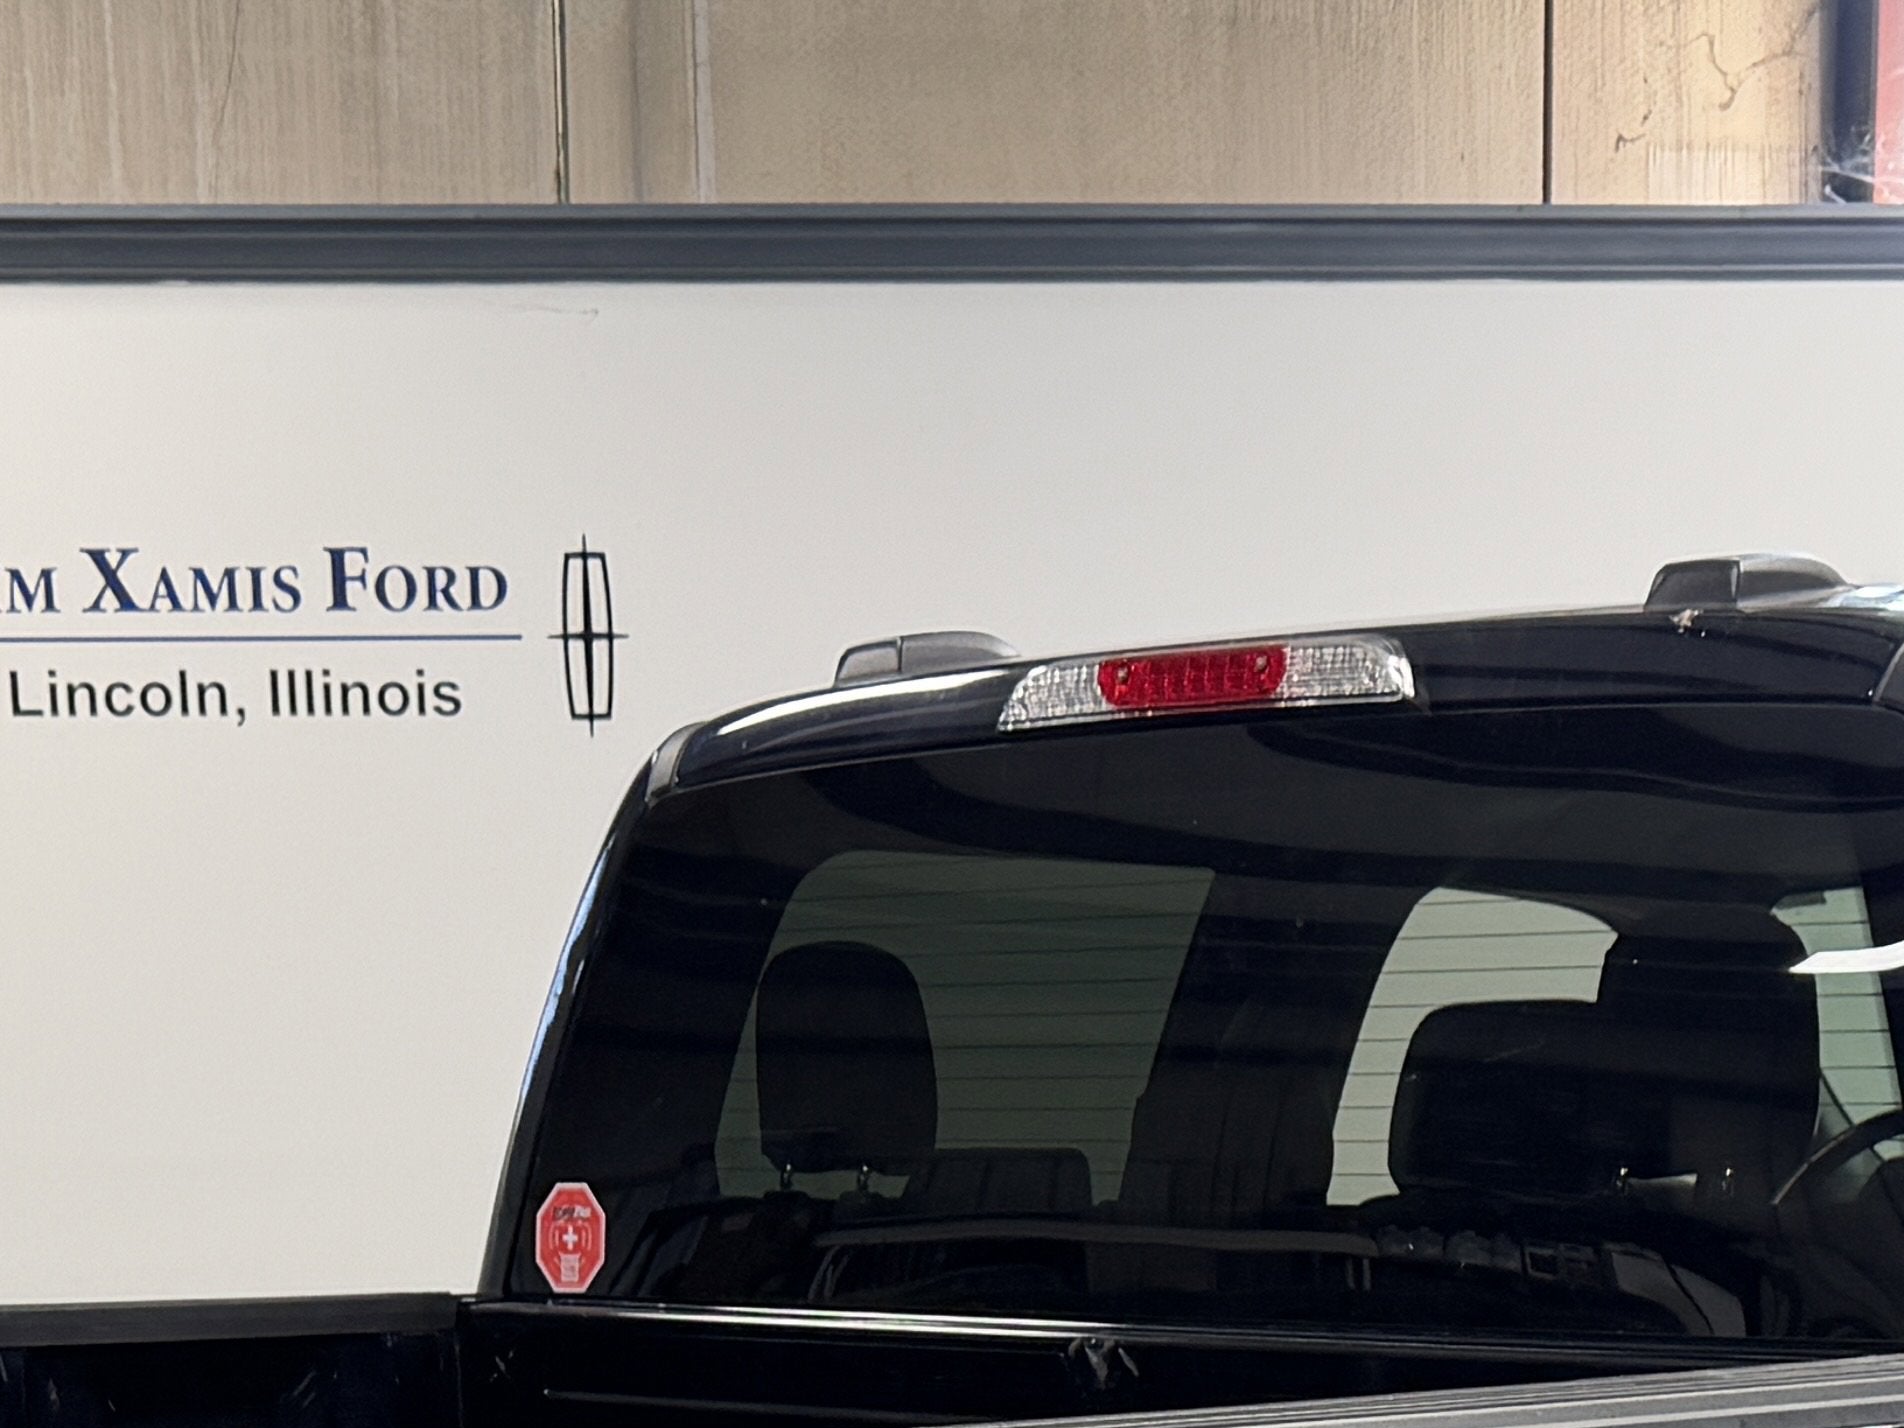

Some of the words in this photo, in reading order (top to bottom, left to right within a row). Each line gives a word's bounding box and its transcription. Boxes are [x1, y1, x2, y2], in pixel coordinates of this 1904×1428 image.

[79, 547, 302, 613] XAMIS
[323, 546, 508, 613] FORD
[9, 669, 246, 727] Lincoln,
[270, 669, 463, 717] Illinois
